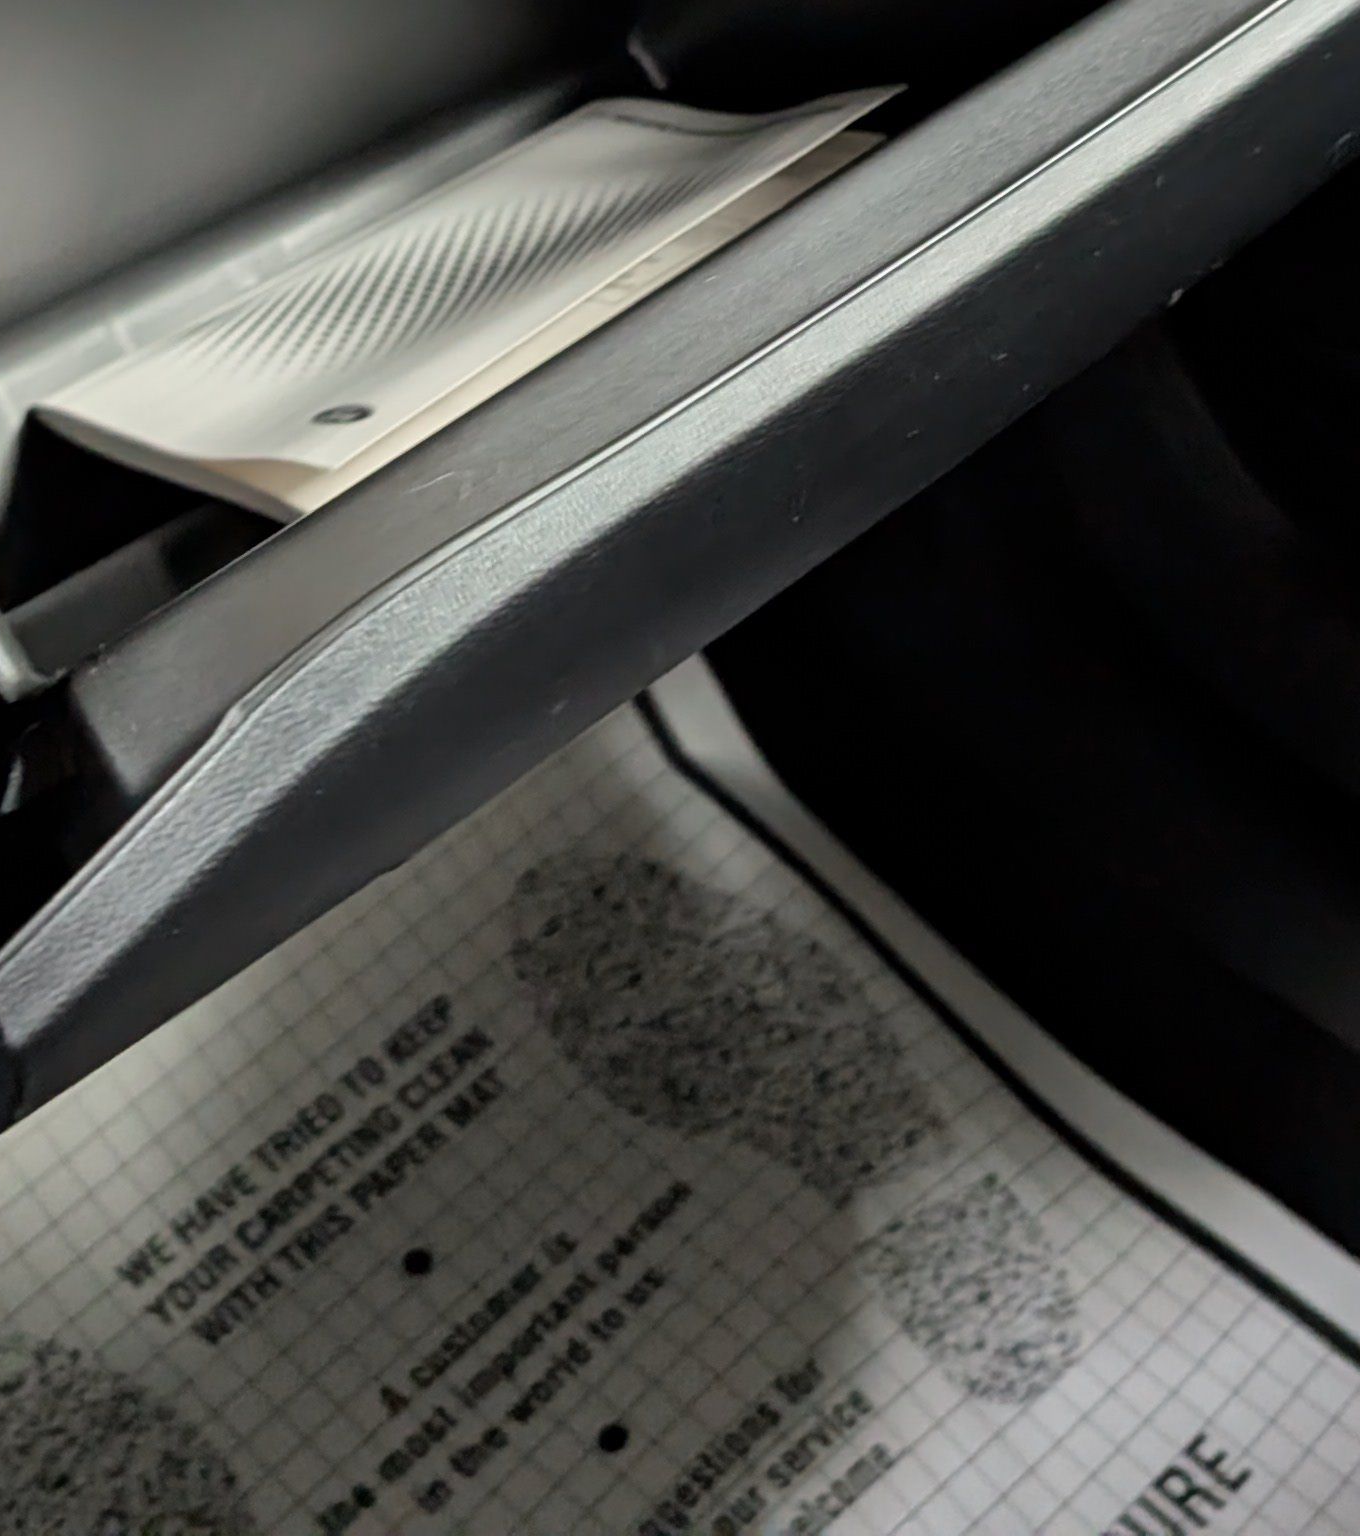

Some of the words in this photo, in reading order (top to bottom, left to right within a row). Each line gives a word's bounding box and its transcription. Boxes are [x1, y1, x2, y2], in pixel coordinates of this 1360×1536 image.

[117, 1235, 174, 1287] WE
[170, 1164, 256, 1244] HAVE
[251, 1094, 345, 1171] TRIED
[341, 1057, 386, 1097] TO
[385, 994, 452, 1060] KEEP
[146, 1244, 239, 1324] YOUR
[236, 1104, 401, 1250] CARPETING
[398, 1026, 493, 1111] CLEAN
[192, 1271, 282, 1345] WITH
[276, 1205, 355, 1272] THIS
[347, 1122, 447, 1212] PAPER
[444, 1068, 505, 1126] MAT
[379, 1406, 457, 1482] most
[449, 1272, 597, 1408] important
[596, 1182, 691, 1277] person
[410, 1264, 541, 1389] customer
[450, 1426, 508, 1476] the
[509, 1338, 592, 1422] world
[587, 1308, 625, 1341] to
[624, 1267, 665, 1307] us
[774, 1357, 824, 1404] for
[767, 1390, 872, 1488] service
[1102, 1432, 1252, 1535] URE
